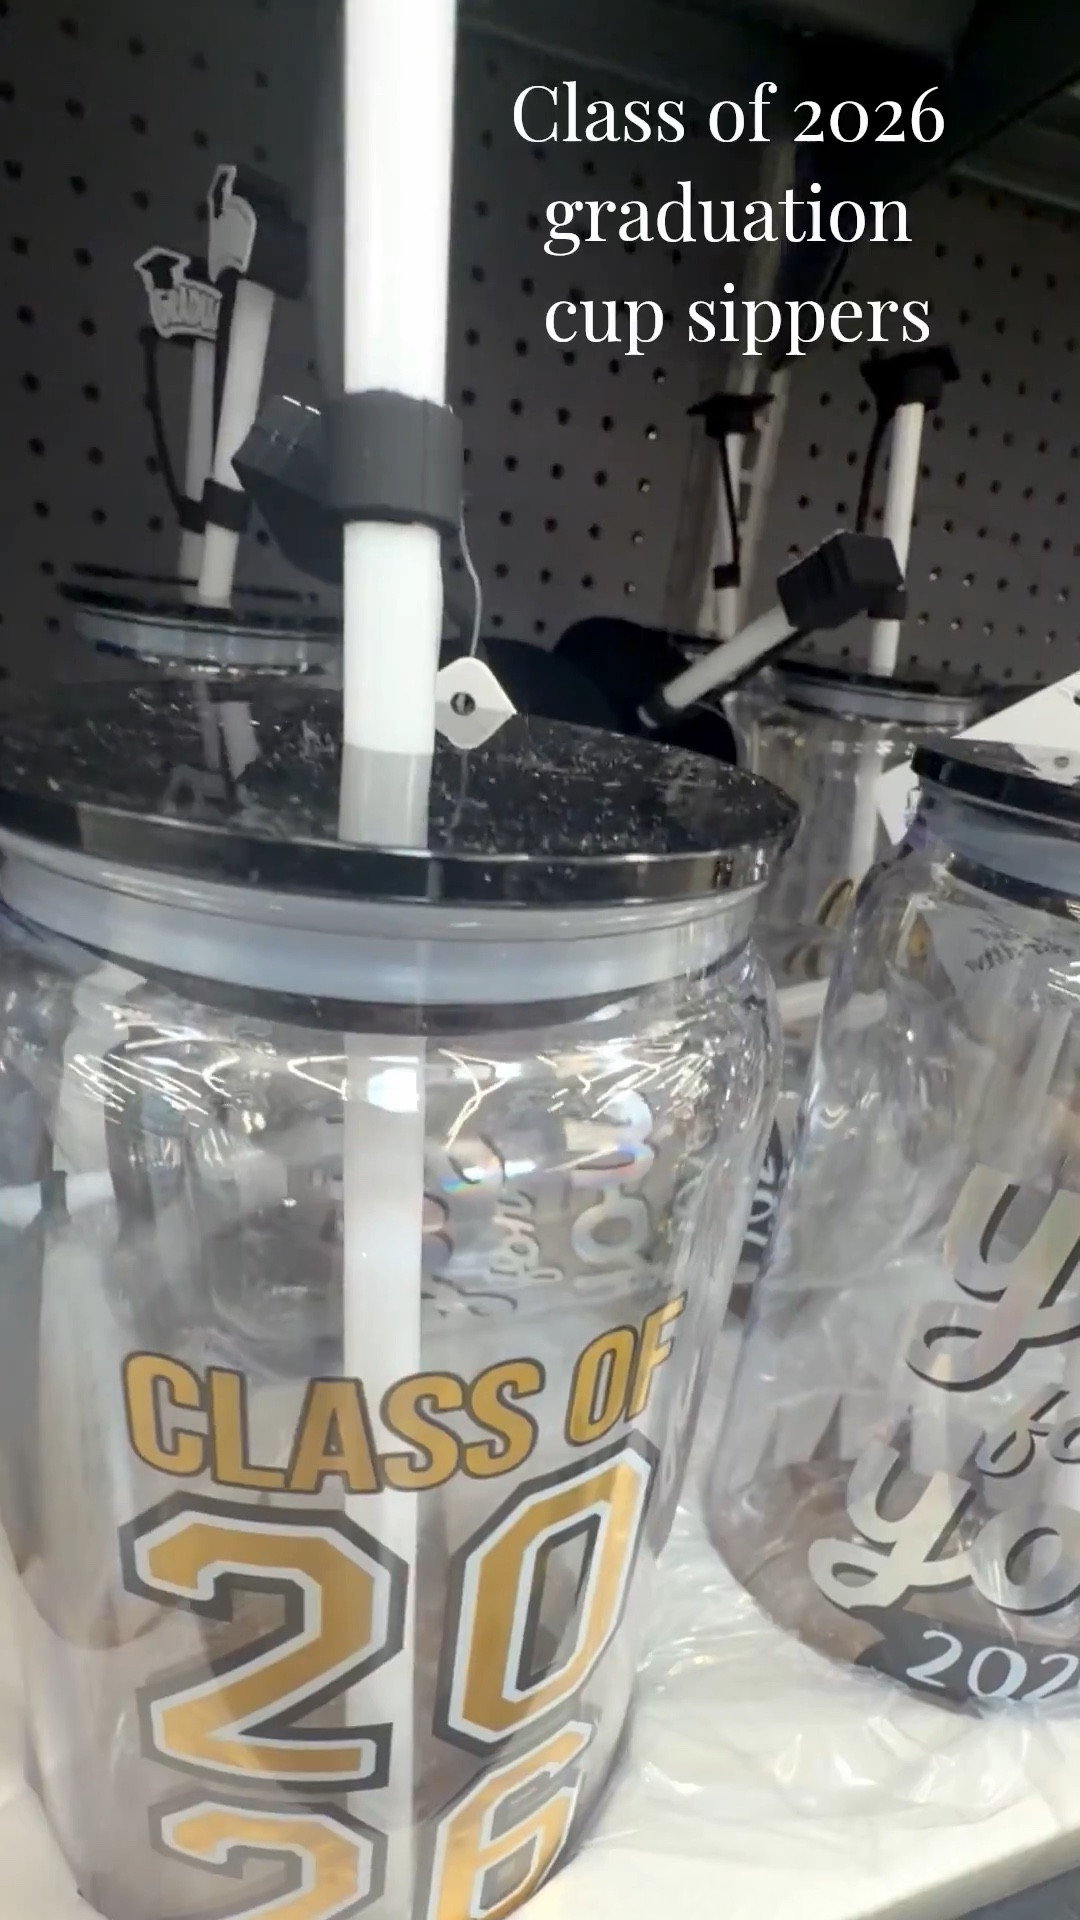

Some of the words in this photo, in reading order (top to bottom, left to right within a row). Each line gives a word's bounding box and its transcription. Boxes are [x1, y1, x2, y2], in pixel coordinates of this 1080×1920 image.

[121, 1350, 546, 1495] CLASS
[563, 1293, 688, 1446] OF
[117, 1428, 662, 1793] 20
